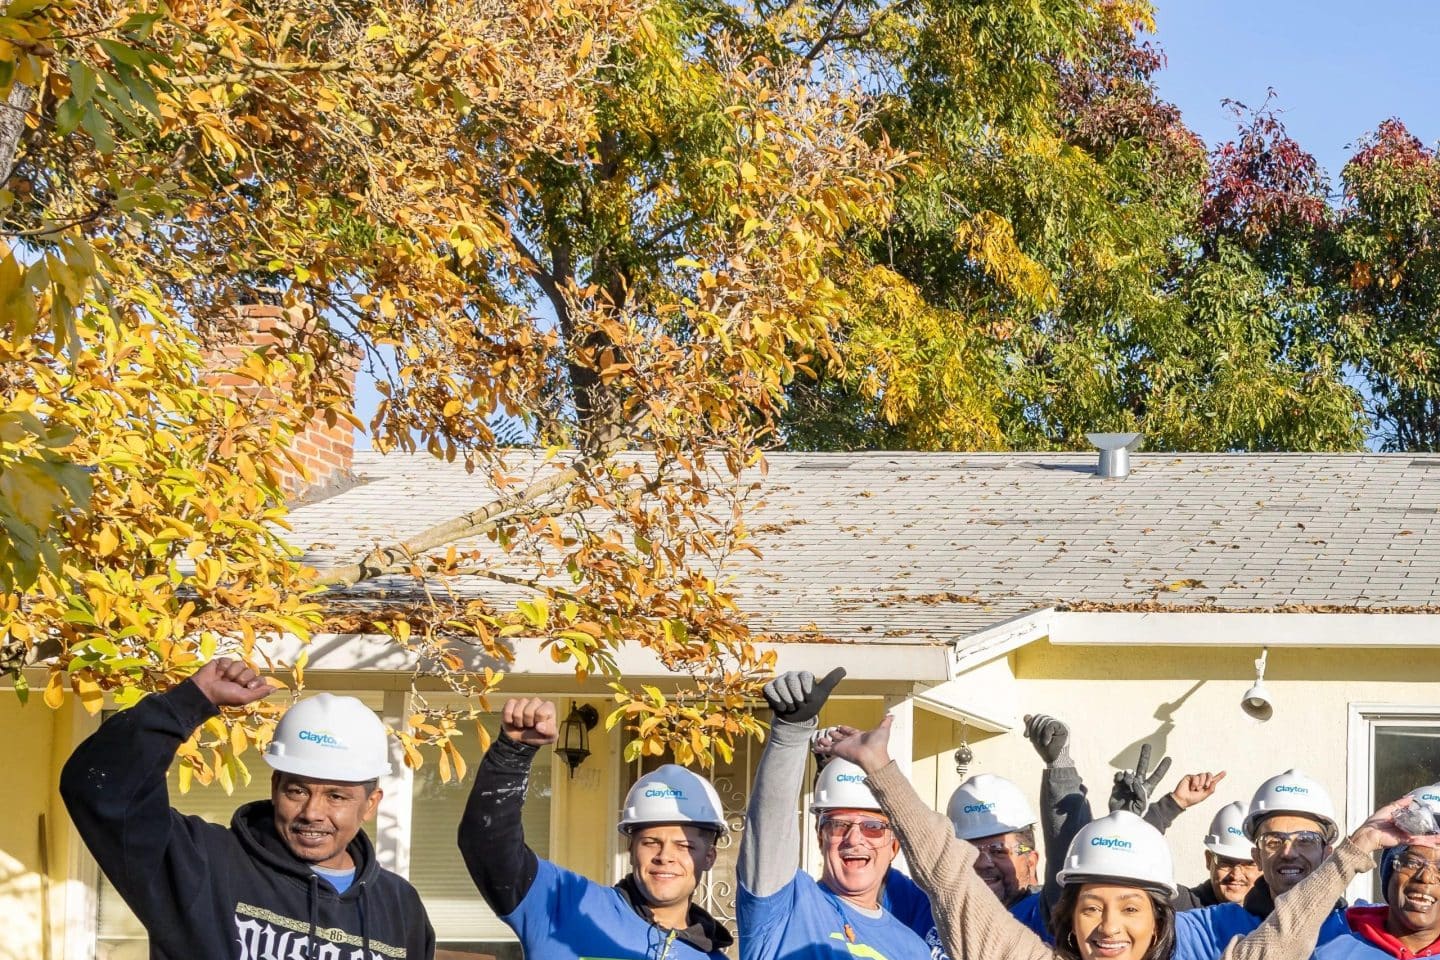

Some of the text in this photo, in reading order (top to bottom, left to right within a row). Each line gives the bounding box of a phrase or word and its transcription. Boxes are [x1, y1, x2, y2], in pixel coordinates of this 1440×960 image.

[298, 730, 340, 744] Clayto
[837, 773, 865, 783] Clayto
[645, 789, 682, 798] Clayton
[1275, 785, 1308, 794] Clayton
[964, 802, 995, 814] Clayton
[1091, 837, 1132, 849] Clayton
